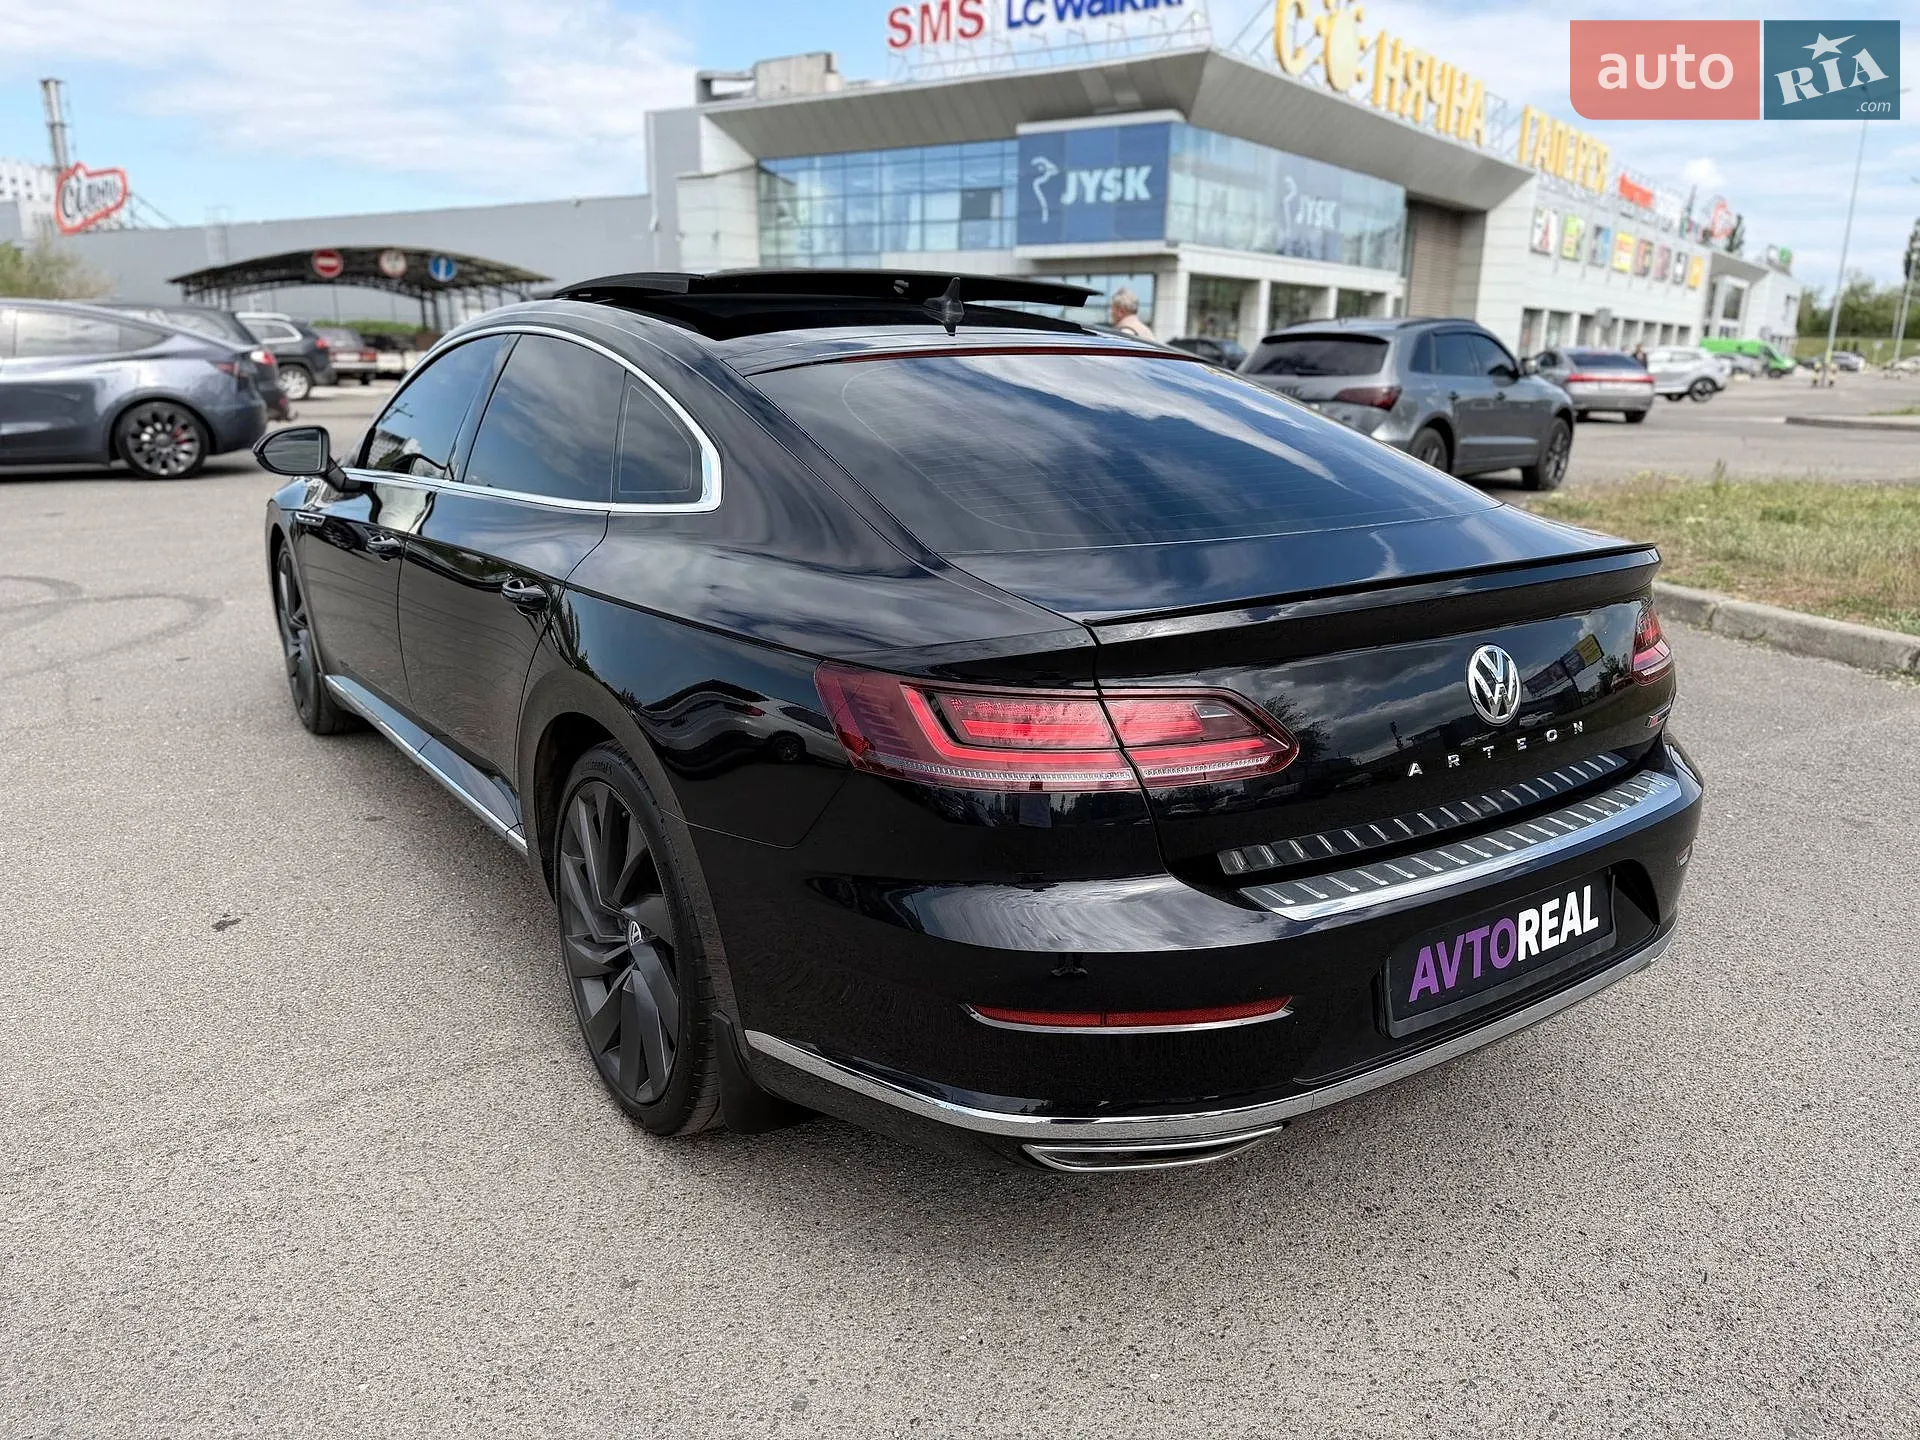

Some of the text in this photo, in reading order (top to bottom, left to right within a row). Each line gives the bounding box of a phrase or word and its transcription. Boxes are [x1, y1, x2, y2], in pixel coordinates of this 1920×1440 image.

[888, 0, 985, 49] SMS
[1007, 0, 1046, 28] LC
[1060, 166, 1152, 205] JYSK
[1408, 720, 1583, 777] ARTEON
